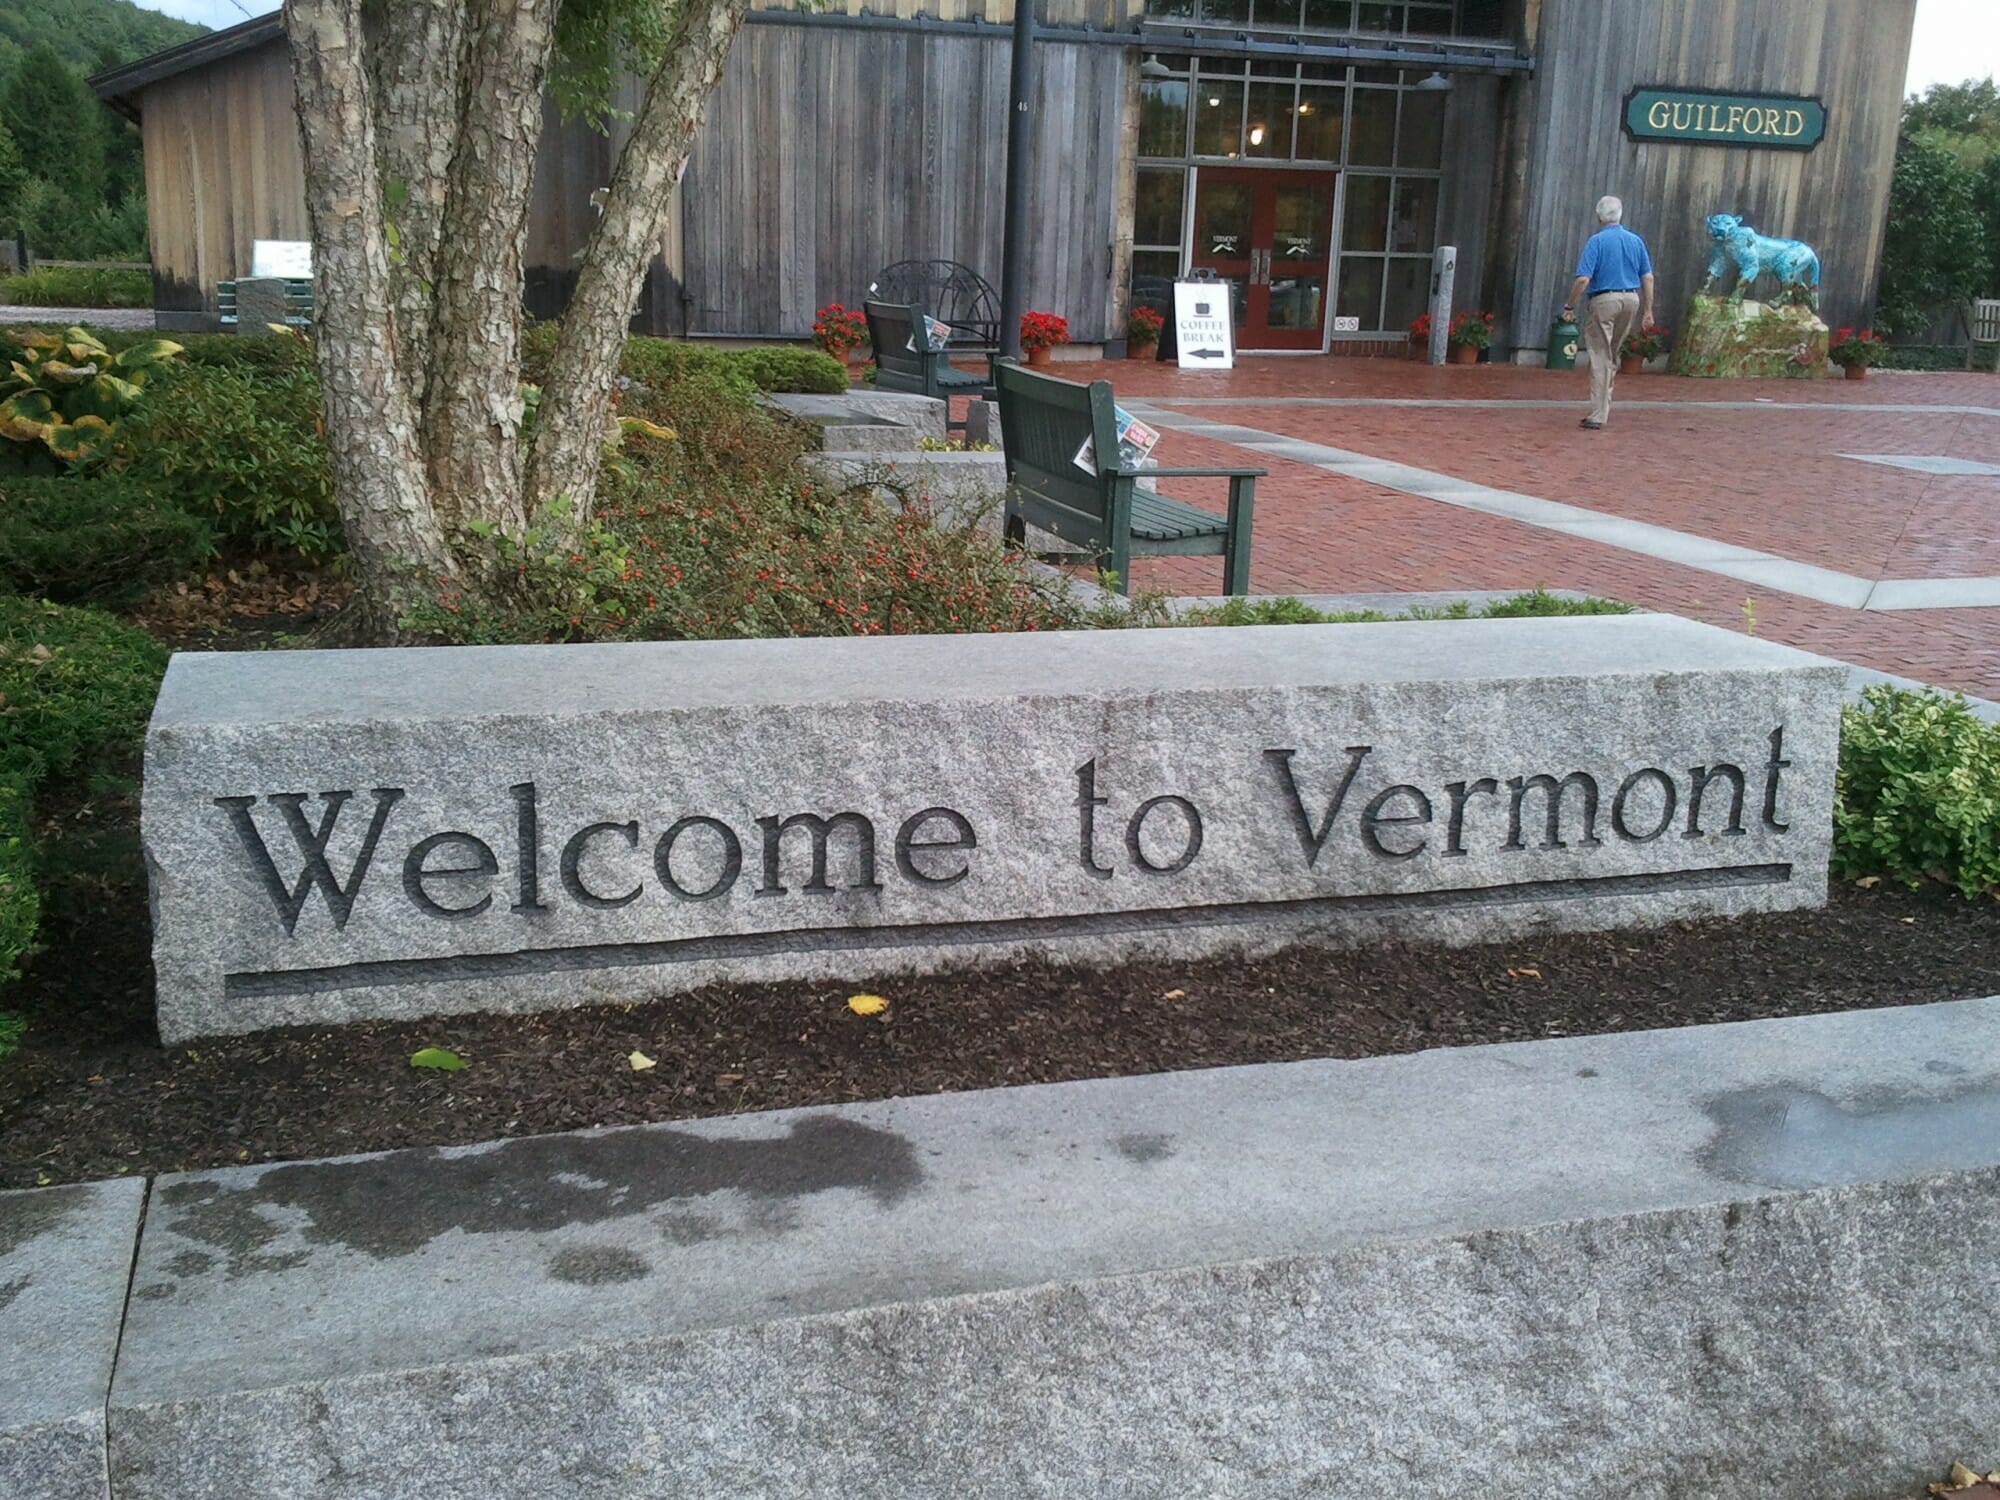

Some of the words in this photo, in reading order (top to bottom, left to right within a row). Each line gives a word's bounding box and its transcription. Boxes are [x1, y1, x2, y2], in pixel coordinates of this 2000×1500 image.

[1648, 100, 1804, 137] GUILFORD
[1180, 320, 1224, 331] COFFEE
[1183, 333, 1224, 343] BREAK
[214, 781, 978, 937] Welcome
[1073, 757, 1202, 881] to
[1263, 725, 1792, 870] Vermont
